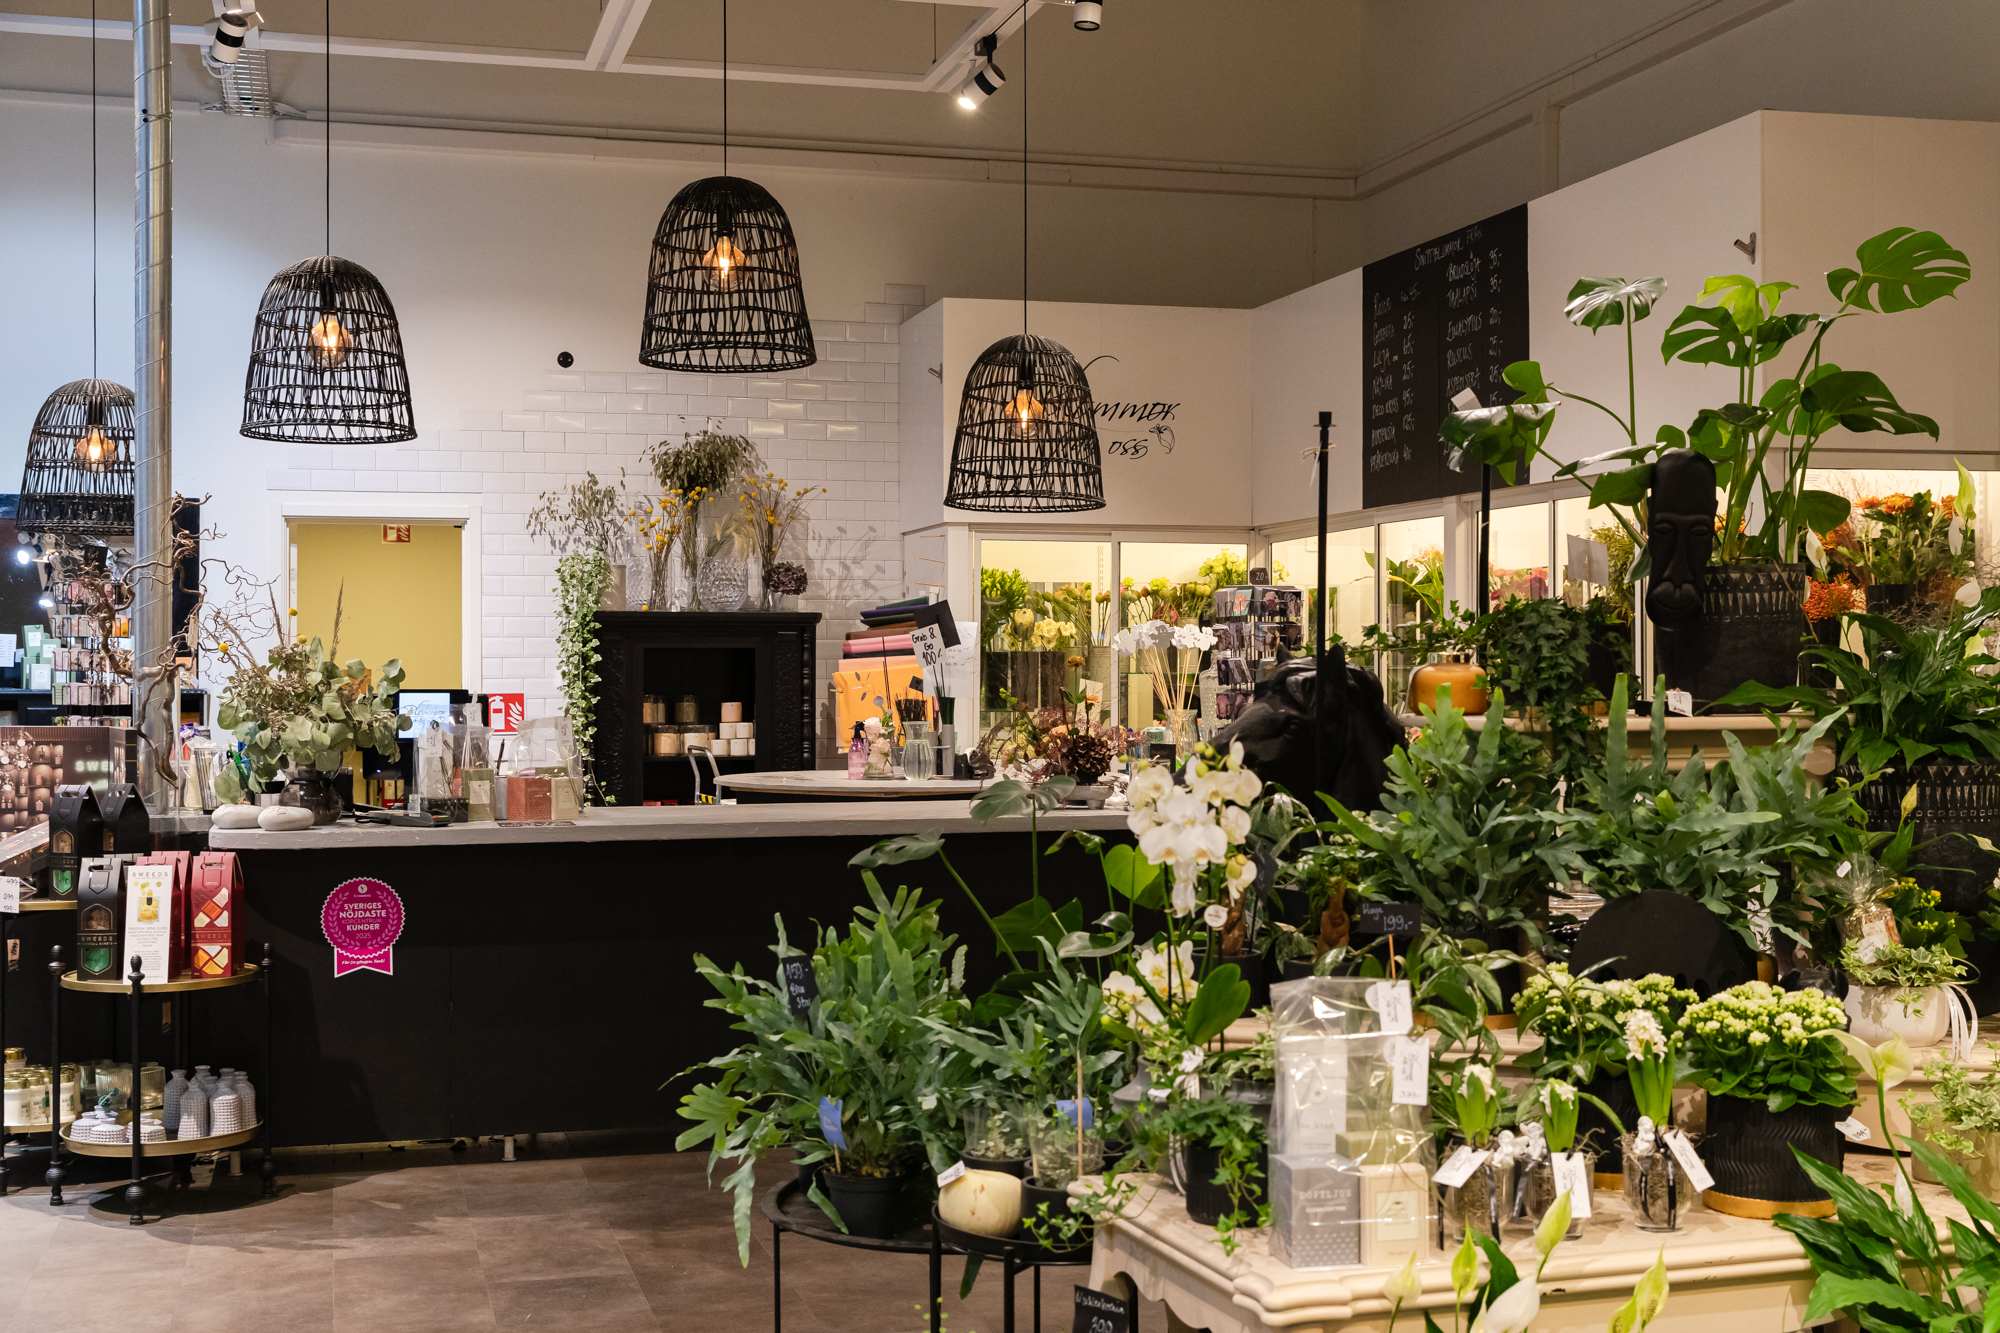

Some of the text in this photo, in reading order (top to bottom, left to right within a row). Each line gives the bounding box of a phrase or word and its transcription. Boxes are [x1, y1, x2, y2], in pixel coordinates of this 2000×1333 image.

[344, 902, 382, 911] SVERIGES
[339, 909, 387, 919] NÖJDASTE
[346, 923, 380, 932] KUNDER
[355, 932, 372, 940] 2025
[1300, 1188, 1353, 1200] DOFTLJUS
